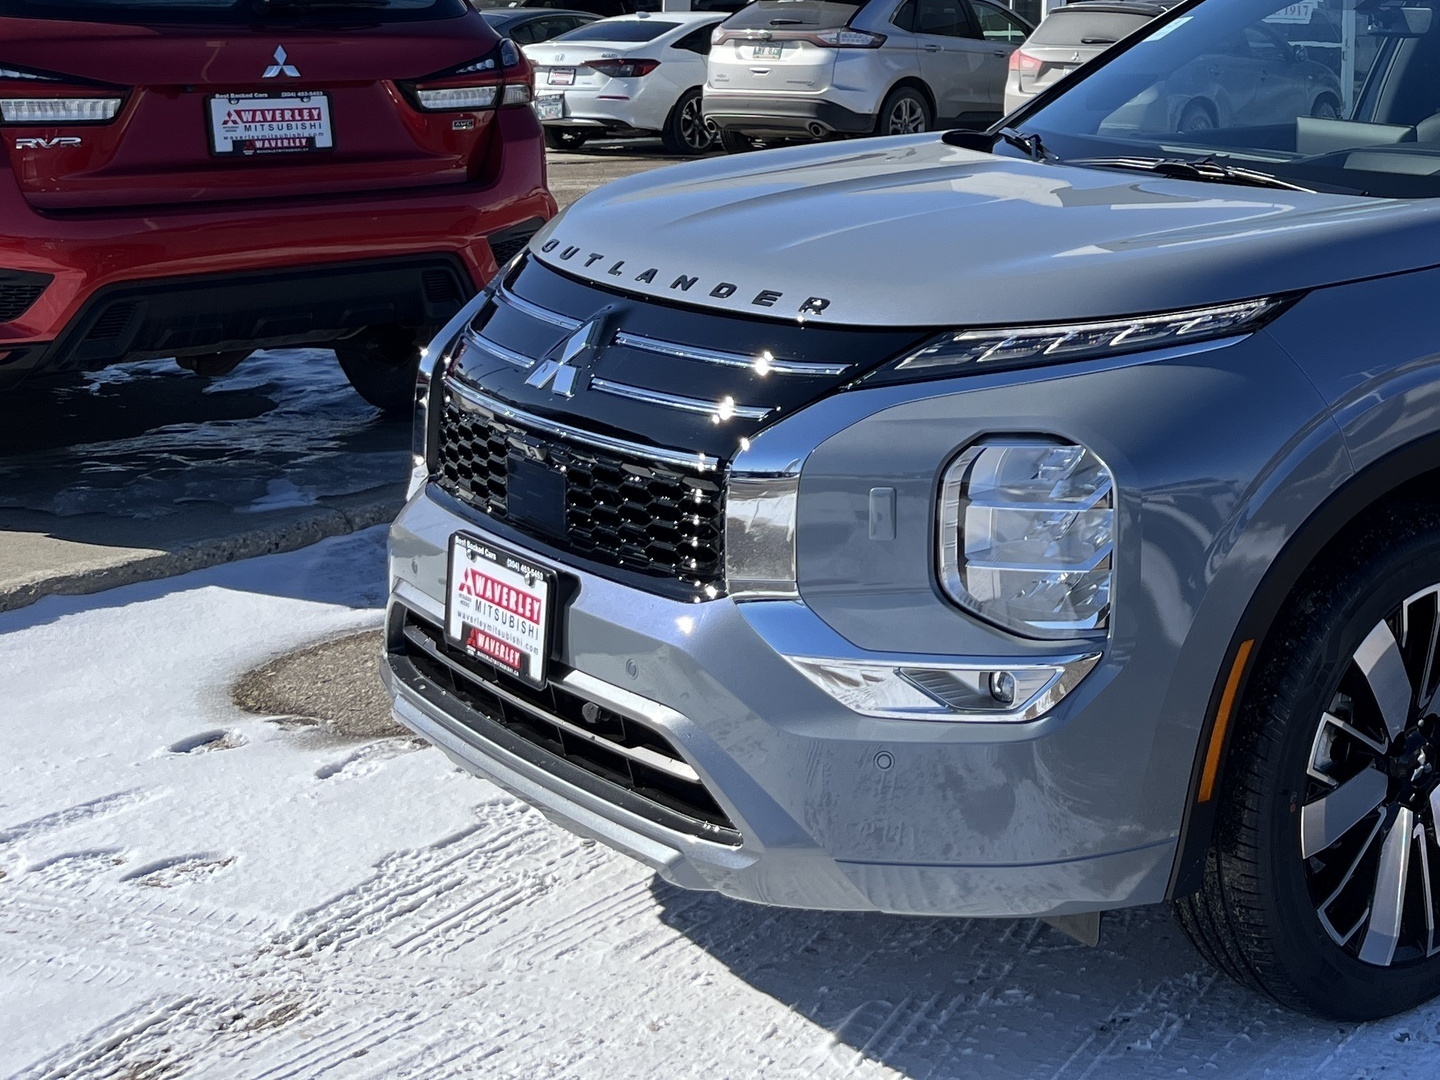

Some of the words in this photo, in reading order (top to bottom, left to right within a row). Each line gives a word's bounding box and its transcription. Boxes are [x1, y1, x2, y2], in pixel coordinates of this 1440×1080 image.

[240, 109, 320, 122] WAVERLEY
[244, 122, 322, 132] MITSUBISHI
[15, 137, 81, 149] RVR
[255, 138, 307, 148] WAVERLEY
[541, 239, 831, 316] OUTLANDER
[475, 574, 540, 620] WAVERLEY
[457, 610, 539, 655] waverleymitsubishi.com
[475, 599, 539, 640] MITSUBISHI
[477, 632, 520, 666] WAVERLEY
